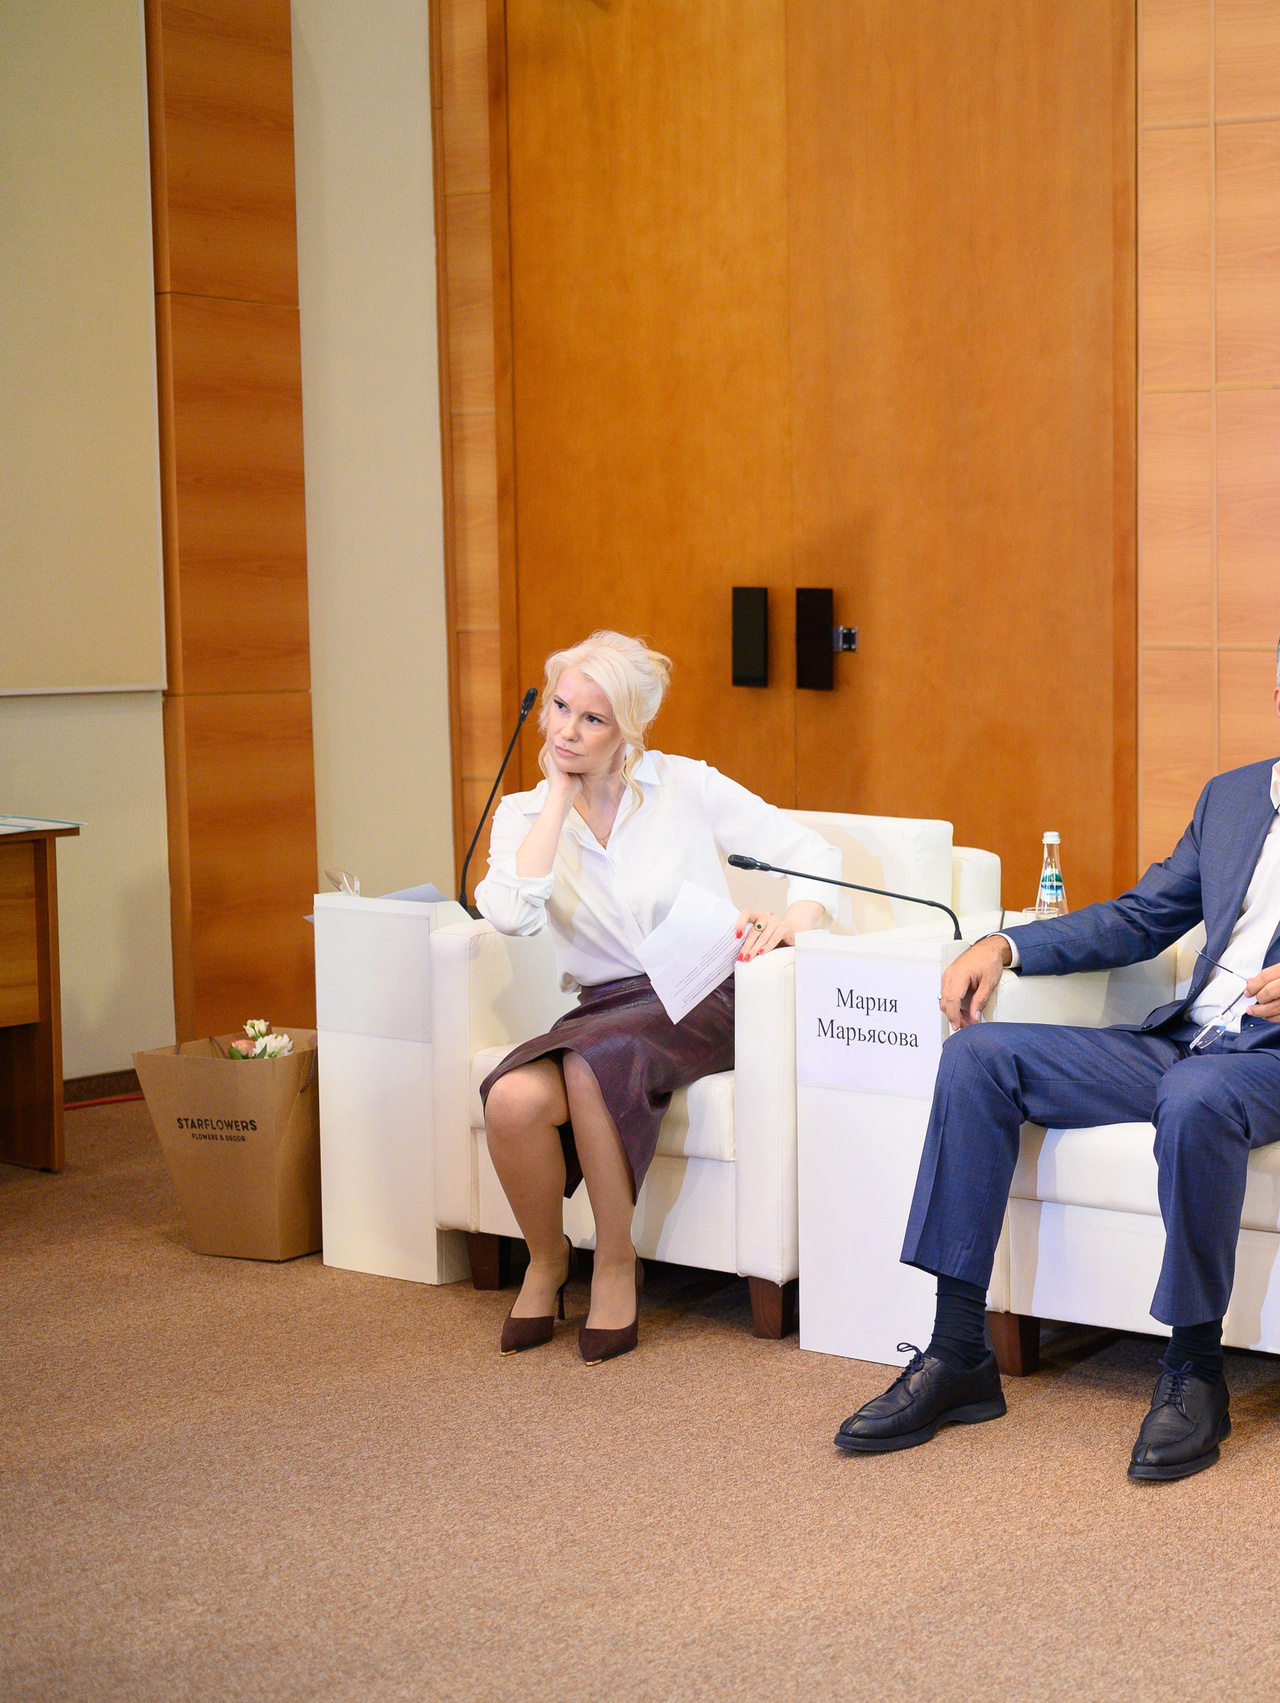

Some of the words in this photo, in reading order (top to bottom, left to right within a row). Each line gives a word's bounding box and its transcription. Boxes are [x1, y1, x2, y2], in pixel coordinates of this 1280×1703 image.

[836, 987, 898, 1016] Мария
[817, 1017, 919, 1048] Марьясова
[176, 1117, 258, 1132] STARFLOWERS
[191, 1133, 218, 1141] FLOWERS
[225, 1134, 246, 1142] DECOR
